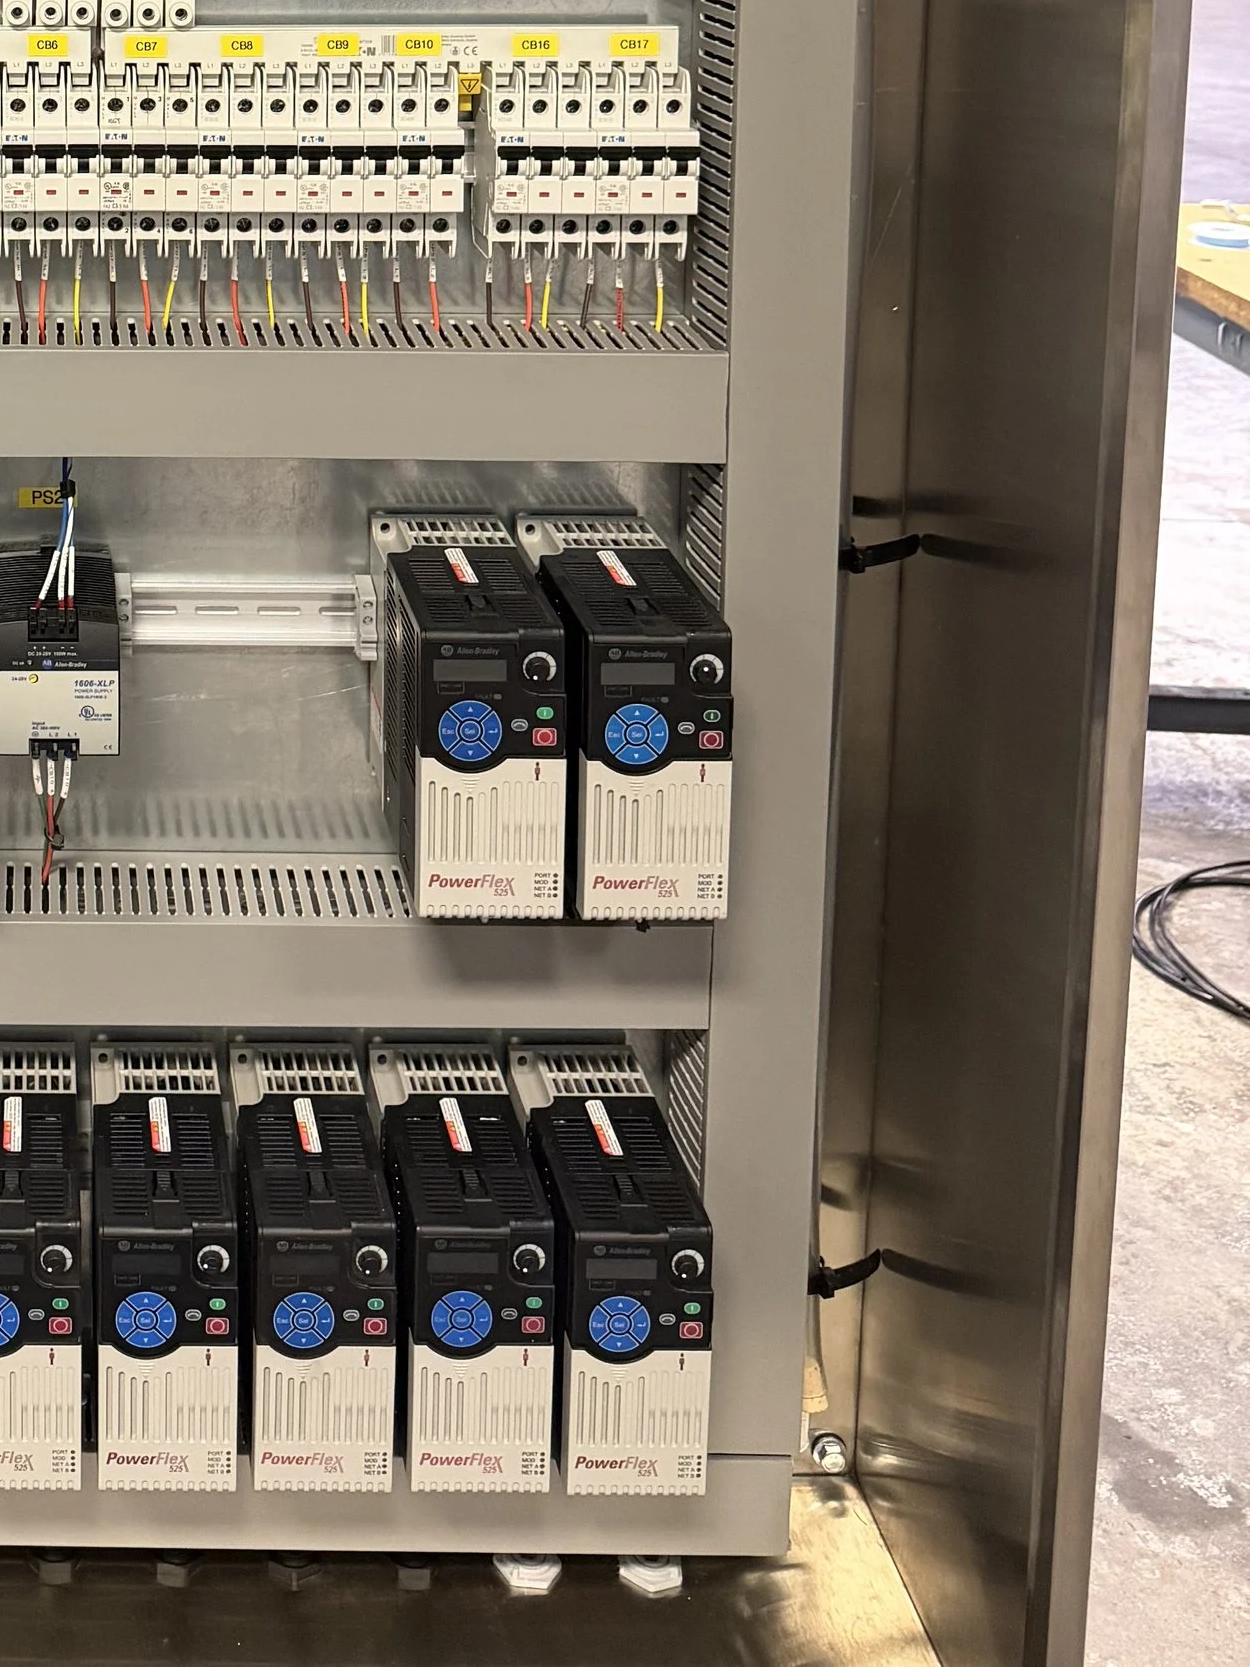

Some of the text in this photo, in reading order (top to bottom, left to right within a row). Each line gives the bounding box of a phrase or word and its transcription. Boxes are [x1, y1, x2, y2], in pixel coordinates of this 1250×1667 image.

[36, 40, 58, 50] CB6
[135, 41, 157, 51] CB7
[231, 40, 253, 50] CB8
[327, 40, 349, 50] CB9
[405, 39, 434, 49] CB10
[522, 39, 550, 50] CB16
[620, 39, 649, 49] CB17
[32, 490, 63, 504] PS2
[428, 874, 515, 896] PowerFlex
[593, 876, 679, 897] PowerFlex
[493, 888, 509, 896] 525
[657, 889, 672, 897] 525
[106, 1452, 189, 1472] PowerFlex
[261, 1452, 344, 1473] PowerFlex
[419, 1453, 503, 1473] PowerFlex
[574, 1456, 658, 1476] PowerFlex
[482, 1466, 497, 1474] 525
